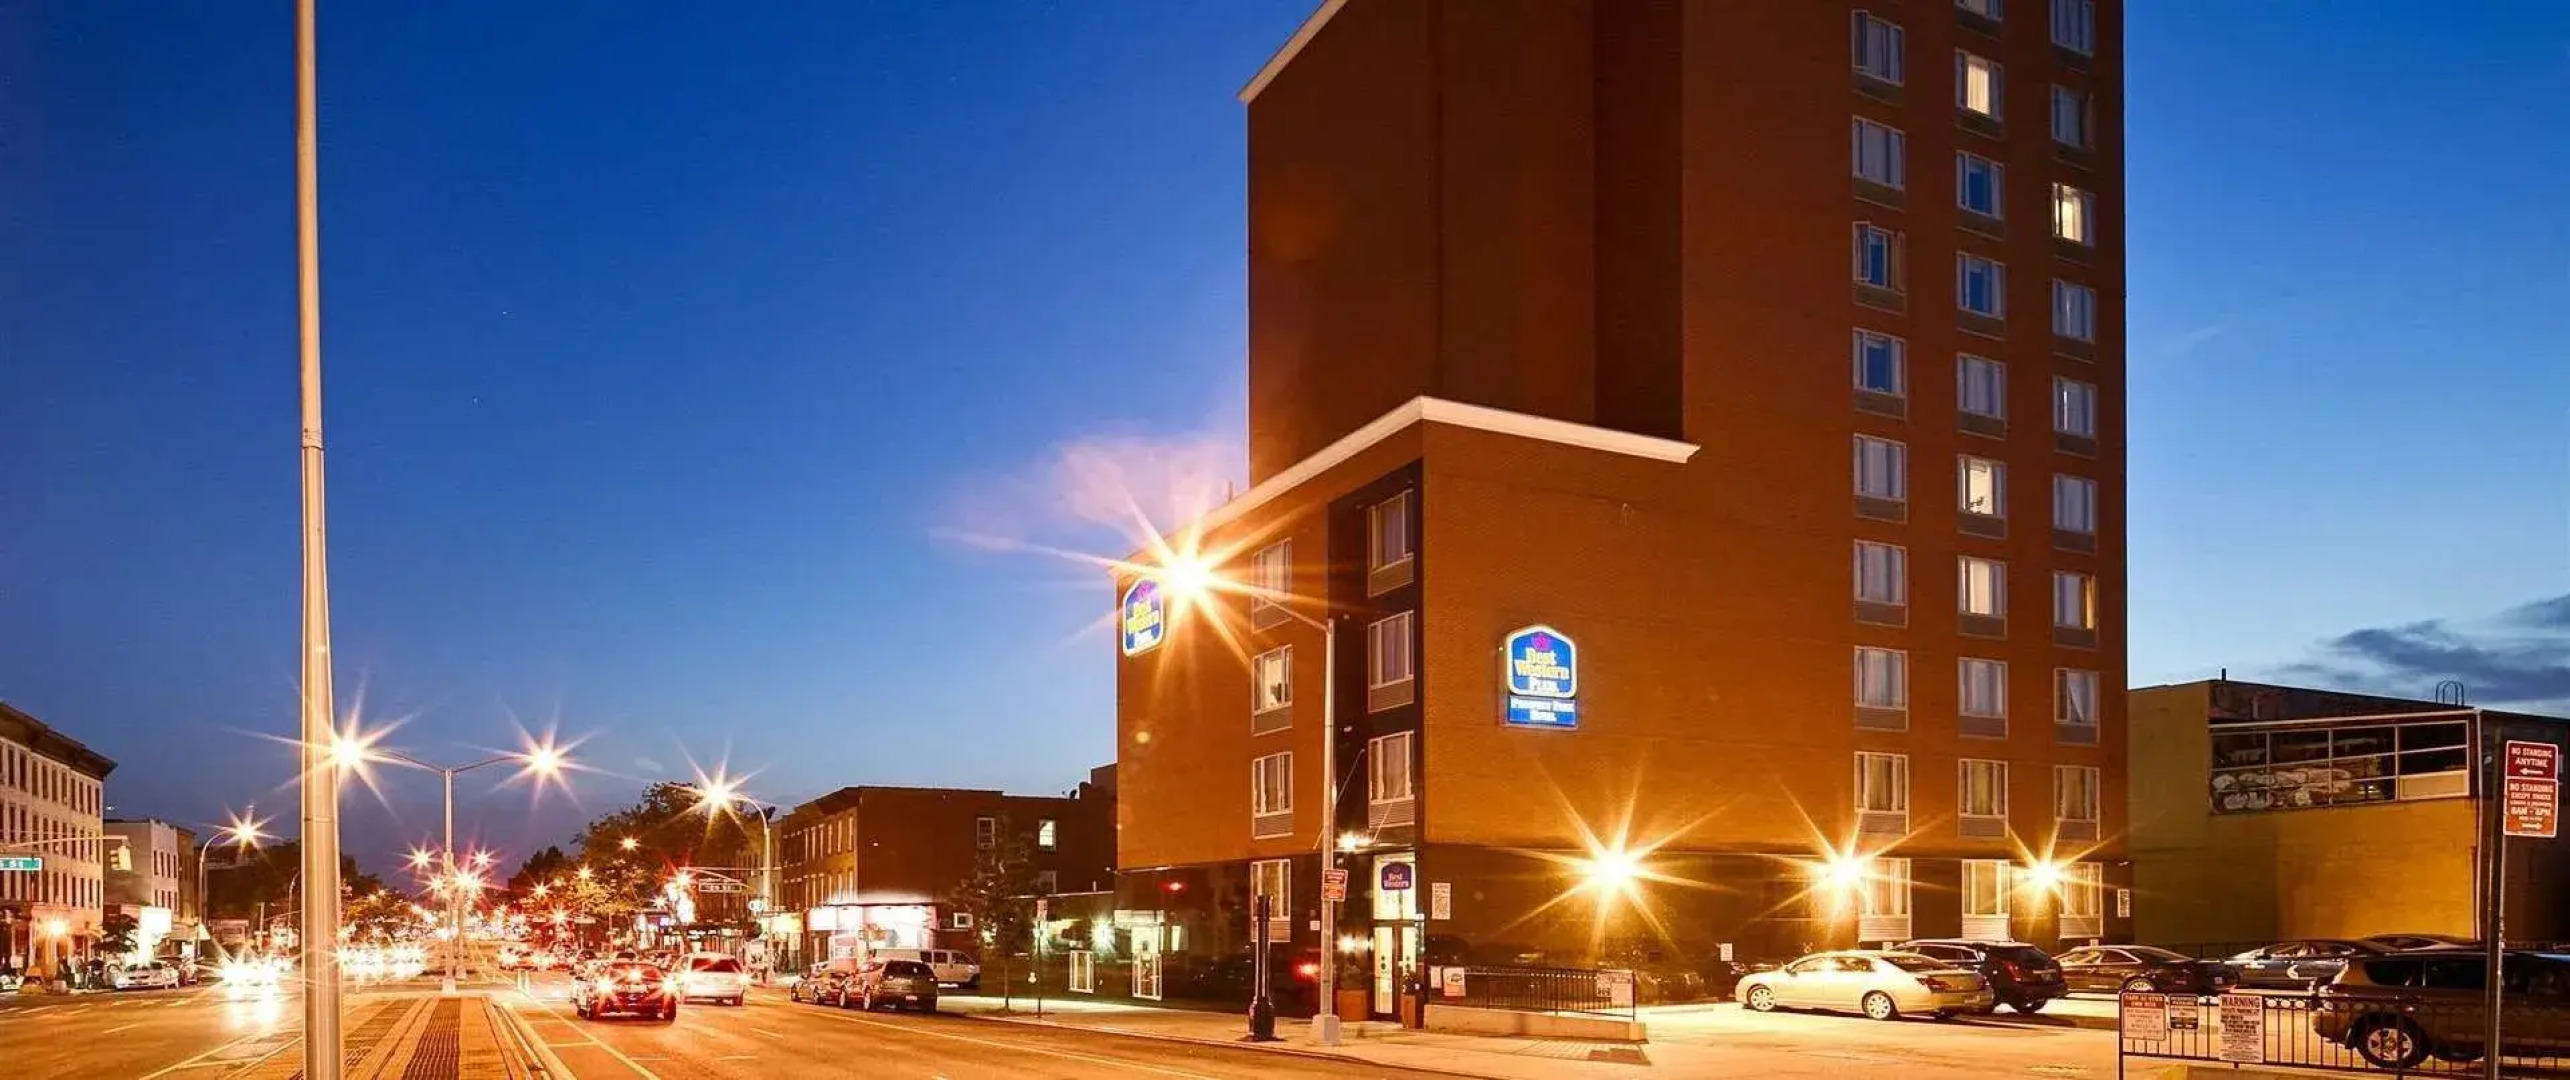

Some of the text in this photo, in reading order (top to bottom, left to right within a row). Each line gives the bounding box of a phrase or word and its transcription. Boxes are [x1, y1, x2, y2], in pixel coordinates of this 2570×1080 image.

[1526, 647, 1557, 666] Best
[1514, 660, 1570, 680] Western
[2511, 747, 2553, 758] NO STANDING
[2515, 758, 2548, 767] ANYTIME
[2509, 783, 2554, 793] NO STANDING
[2222, 996, 2260, 1008] WARNING
